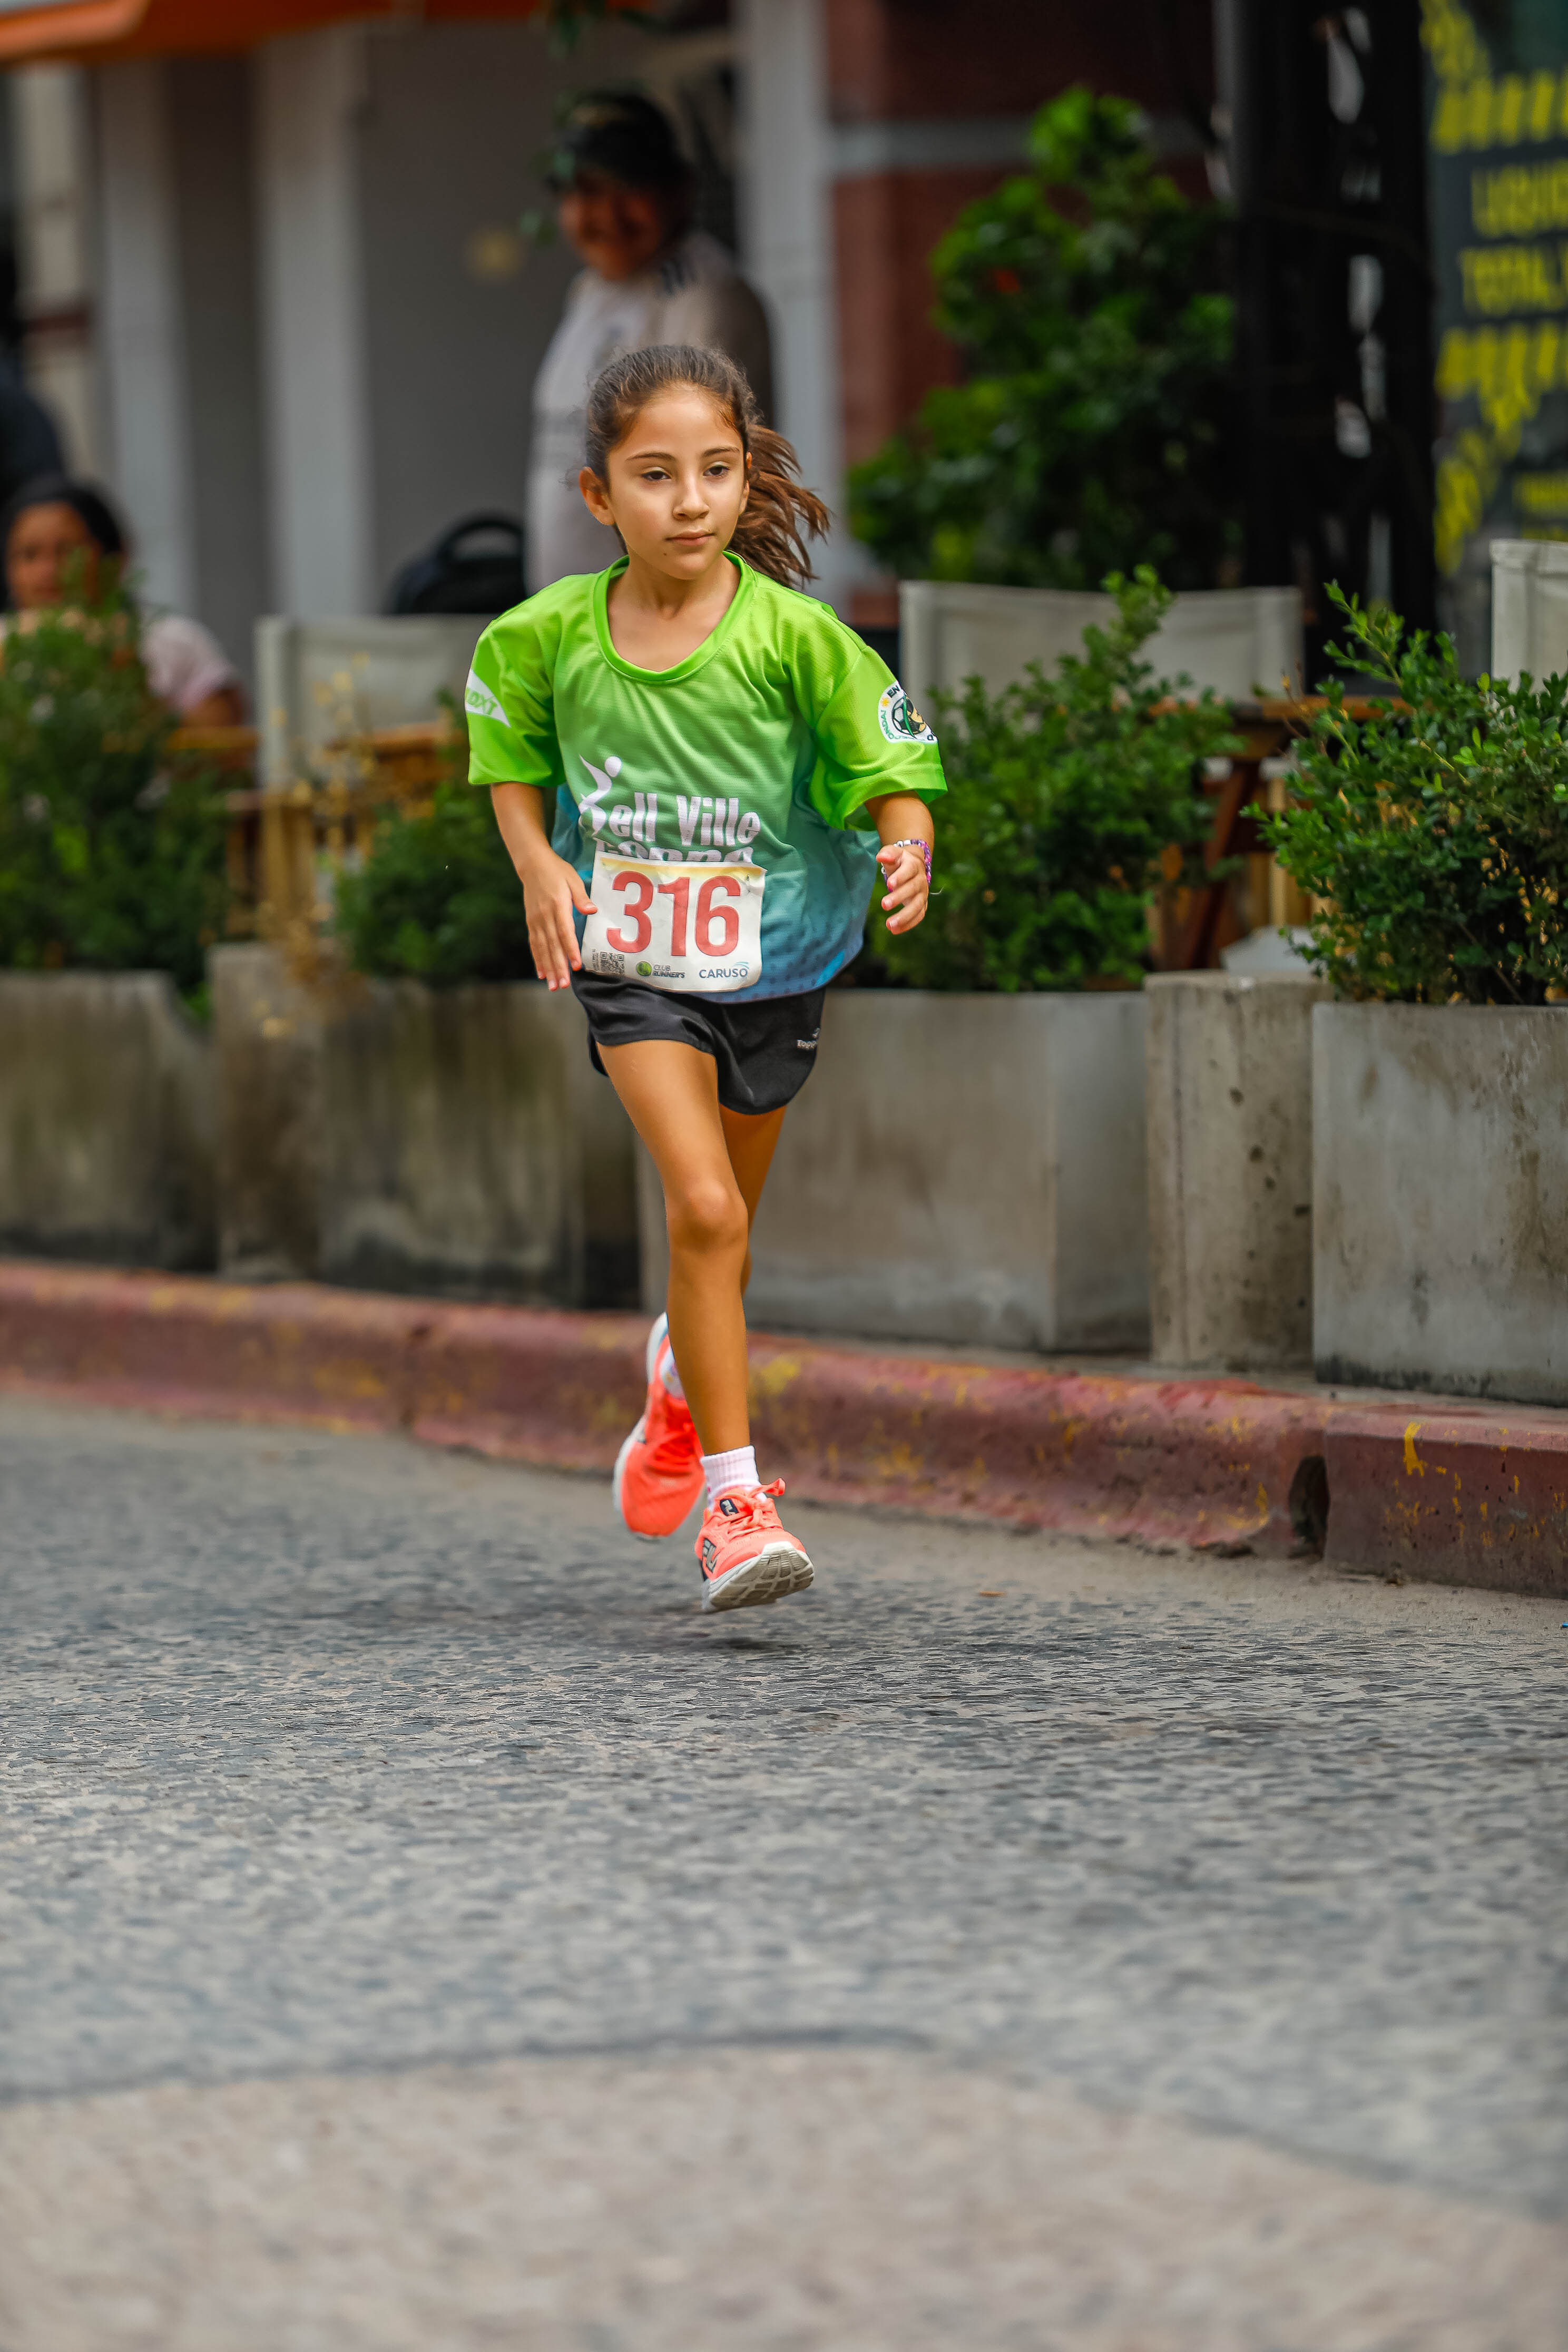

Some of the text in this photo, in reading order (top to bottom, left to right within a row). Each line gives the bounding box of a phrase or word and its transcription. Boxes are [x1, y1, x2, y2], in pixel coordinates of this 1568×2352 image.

[676, 795, 761, 846] Ville
[606, 870, 741, 957] 316
[699, 968, 748, 978] CARUSO
